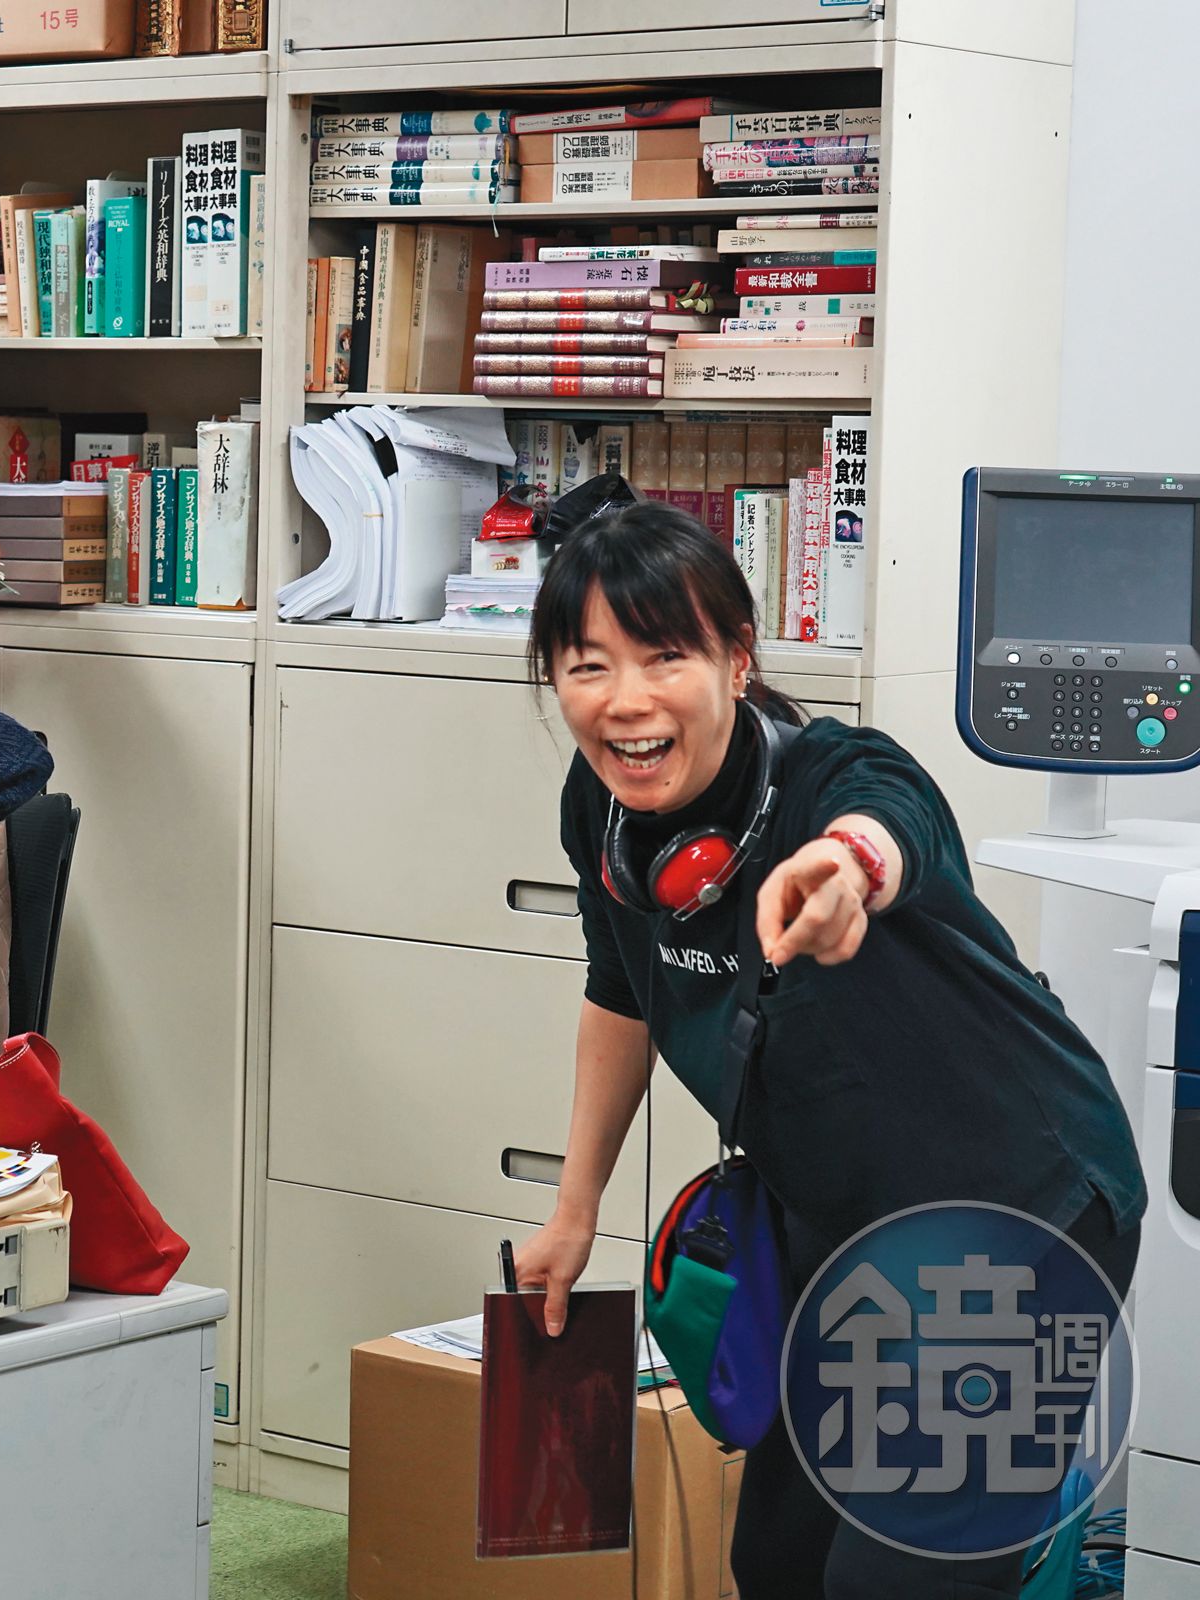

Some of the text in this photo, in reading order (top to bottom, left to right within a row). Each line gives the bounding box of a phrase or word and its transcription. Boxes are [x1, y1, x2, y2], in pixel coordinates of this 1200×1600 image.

[40, 8, 79, 30] 15号
[339, 116, 390, 133] 大事典
[735, 113, 841, 135] 手芸百科事典
[335, 140, 385, 158] 大事典
[562, 134, 611, 147] プロ調理師
[210, 140, 237, 165] 料理
[562, 147, 611, 159] の基礎講座
[714, 143, 801, 165] 手芸の百科
[210, 166, 237, 191] 食材
[329, 163, 381, 181] 大事典
[209, 192, 237, 210] 大事典
[327, 186, 379, 203] 大事典
[108, 219, 130, 228] ROYAL
[155, 170, 170, 283] リーダーズ英和辞典
[730, 235, 767, 247] 山野愛子
[37, 221, 52, 296] 現代独和辞典
[753, 254, 773, 265] きれ
[586, 264, 650, 282] 懐石 近茶流
[747, 271, 819, 290] 最新和裁全書
[835, 428, 868, 457] 料理
[212, 433, 231, 495] 大辞林
[834, 458, 867, 486] 食材
[820, 439, 832, 549] 山野草カラー百科
[833, 487, 867, 507] 大事典
[111, 474, 126, 559] コンサイス人名辞典
[131, 479, 140, 554] コンサイス人名辞典
[155, 474, 167, 560] コンサイス地名辞典
[184, 476, 196, 562] コンサイス地名辞典
[747, 503, 756, 574] 記者ハンドブック
[658, 943, 722, 975] MILKFED.
